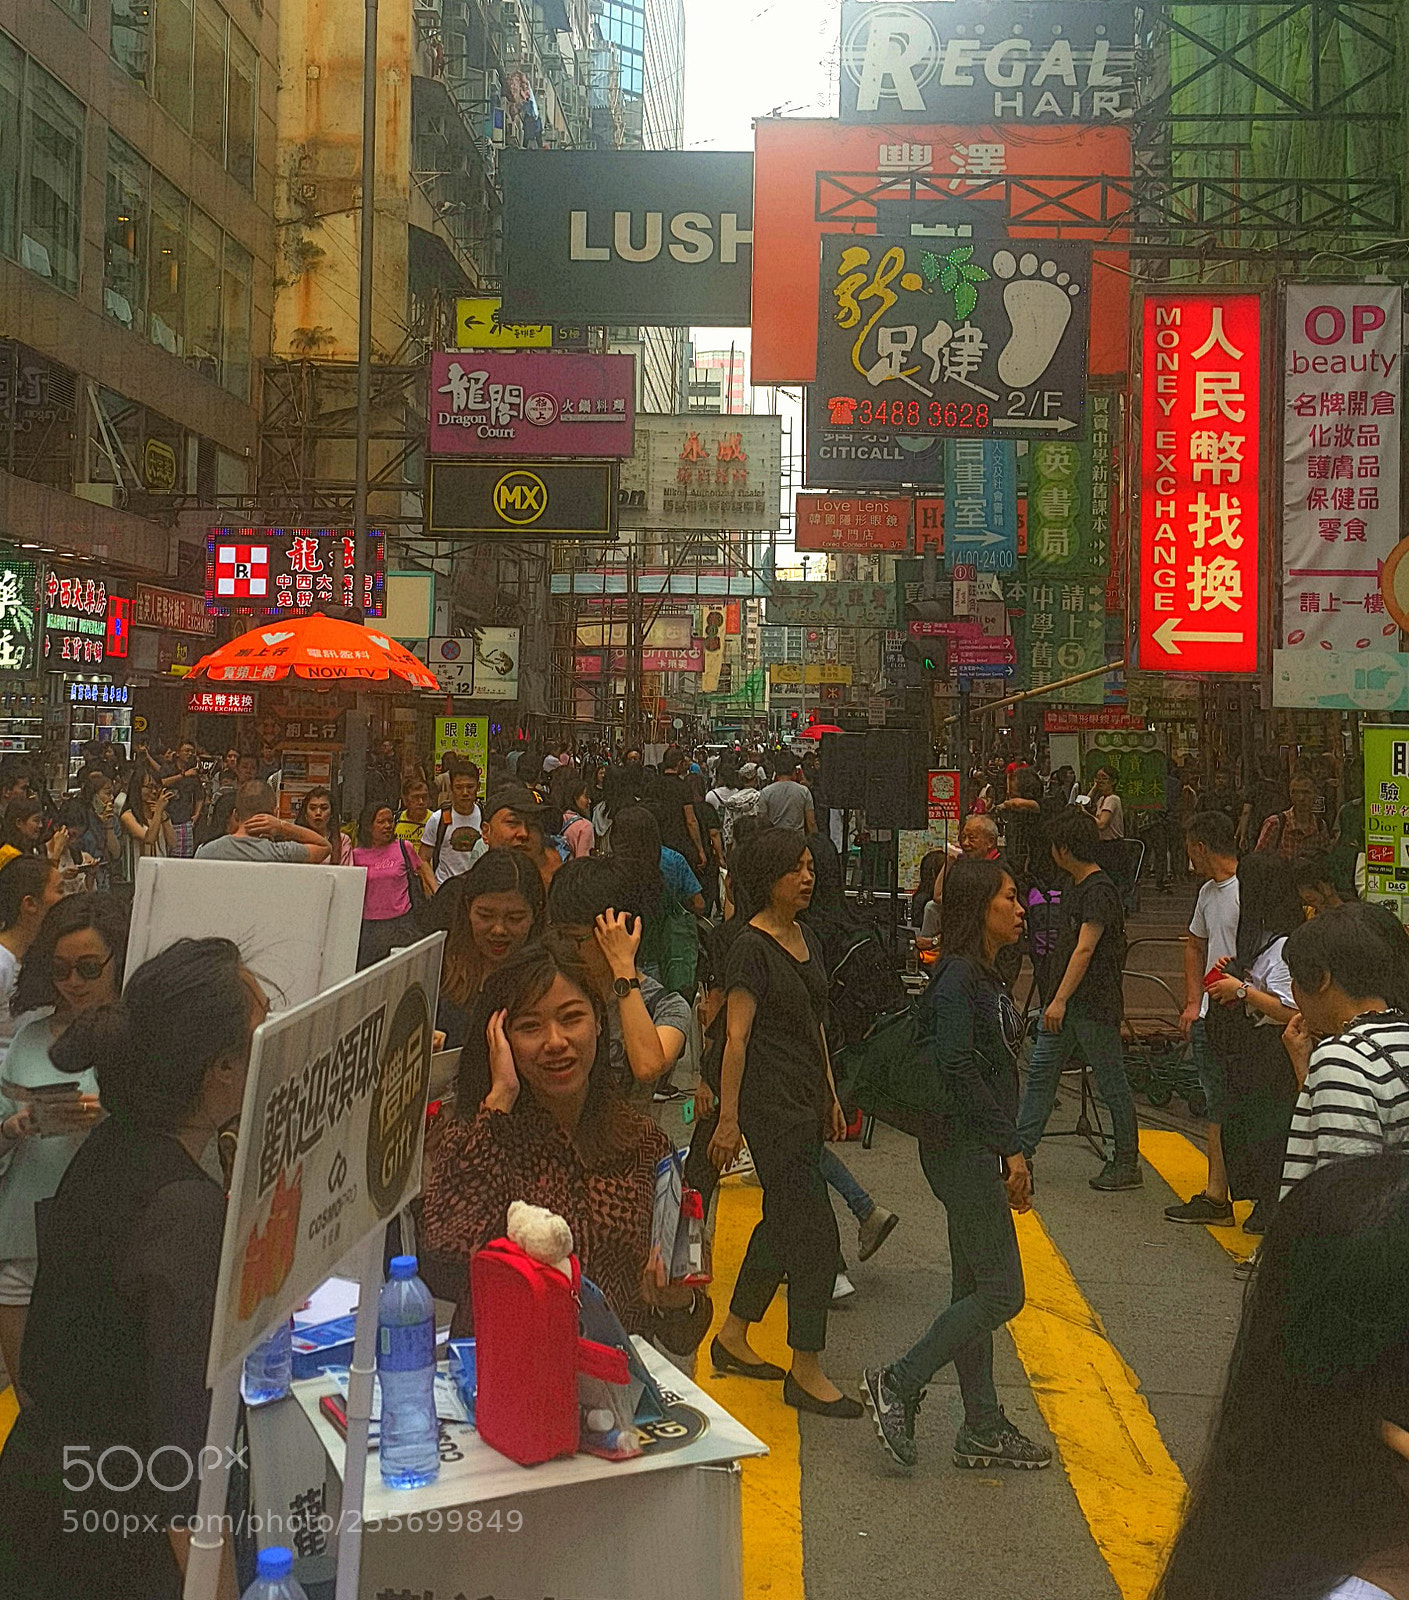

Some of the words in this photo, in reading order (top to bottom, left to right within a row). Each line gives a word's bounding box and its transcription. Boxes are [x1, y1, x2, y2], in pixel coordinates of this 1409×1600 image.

[856, 12, 1123, 111] REGAL
[994, 90, 1125, 118] HAIR
[570, 210, 754, 264] LUSH
[1304, 304, 1387, 347] OP
[1155, 307, 1181, 418] MONEY
[1292, 349, 1398, 379] beauty
[858, 400, 921, 427] 3488
[926, 401, 990, 429] 3628
[1006, 390, 1063, 418] 2/F
[1292, 391, 1397, 418] 名牌開倉
[437, 412, 487, 427] Dragon
[476, 425, 516, 439] Court
[818, 446, 905, 461] CITICALL
[1187, 307, 1246, 613] 人民幣找換
[1307, 454, 1381, 481] 護膚品
[816, 499, 851, 513] Love
[857, 500, 889, 514] Lens
[1305, 485, 1380, 513] 保健品
[1152, 430, 1178, 612] EXCHANGE
[1317, 517, 1369, 544] 零食
[308, 667, 347, 678] NOW
[356, 667, 376, 678] TV
[456, 665, 464, 676] 7
[456, 682, 470, 693] 12
[445, 722, 478, 738] 眼鏡
[1368, 817, 1398, 832] Dior
[1367, 876, 1379, 890] ck
[1388, 881, 1407, 891] D&G
[381, 1117, 412, 1190] Gift
